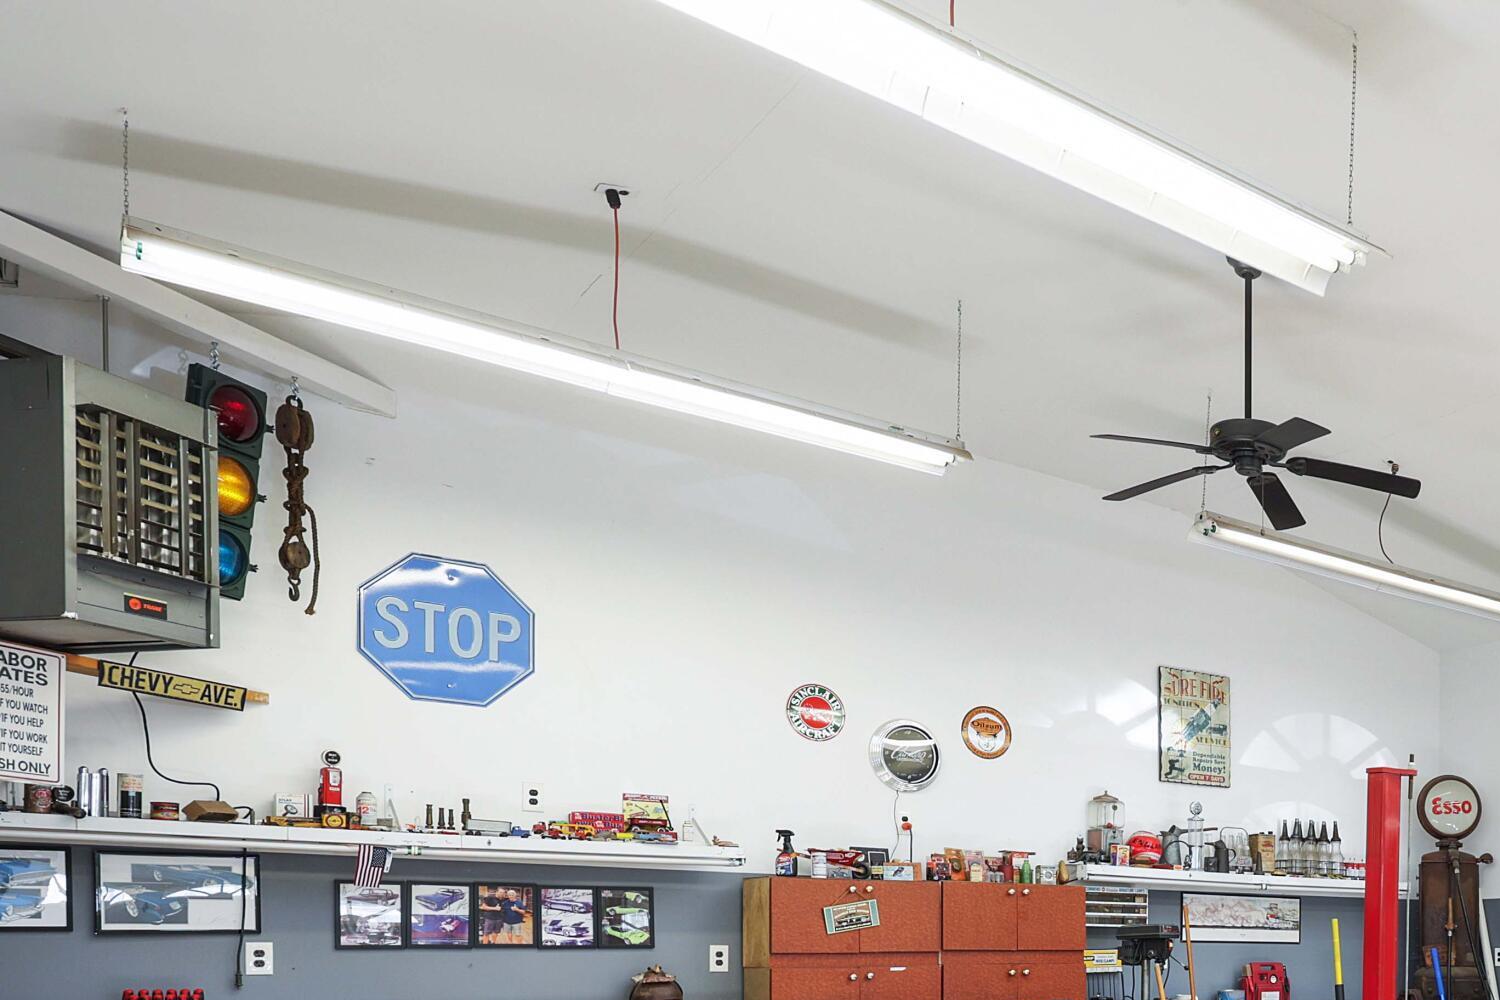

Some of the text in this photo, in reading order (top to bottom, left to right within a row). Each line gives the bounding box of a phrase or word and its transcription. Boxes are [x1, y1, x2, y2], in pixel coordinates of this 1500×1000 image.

[373, 595, 521, 662] STOP
[0, 649, 47, 672] ABOR
[0, 666, 48, 687] ATES
[0, 685, 34, 698] 55/HOUR
[108, 665, 237, 706] CHEVY AVE.
[790, 687, 841, 710] SINCLAIR
[6, 699, 21, 711] YOU
[23, 701, 49, 714] WATCH
[10, 713, 25, 725] YOU
[27, 717, 44, 728] HELP
[9, 729, 24, 741] YOU
[26, 732, 48, 744] WORK
[8, 742, 44, 756] YOURSELF
[0, 758, 51, 774] SH ONLY
[1193, 763, 1226, 775] Money!
